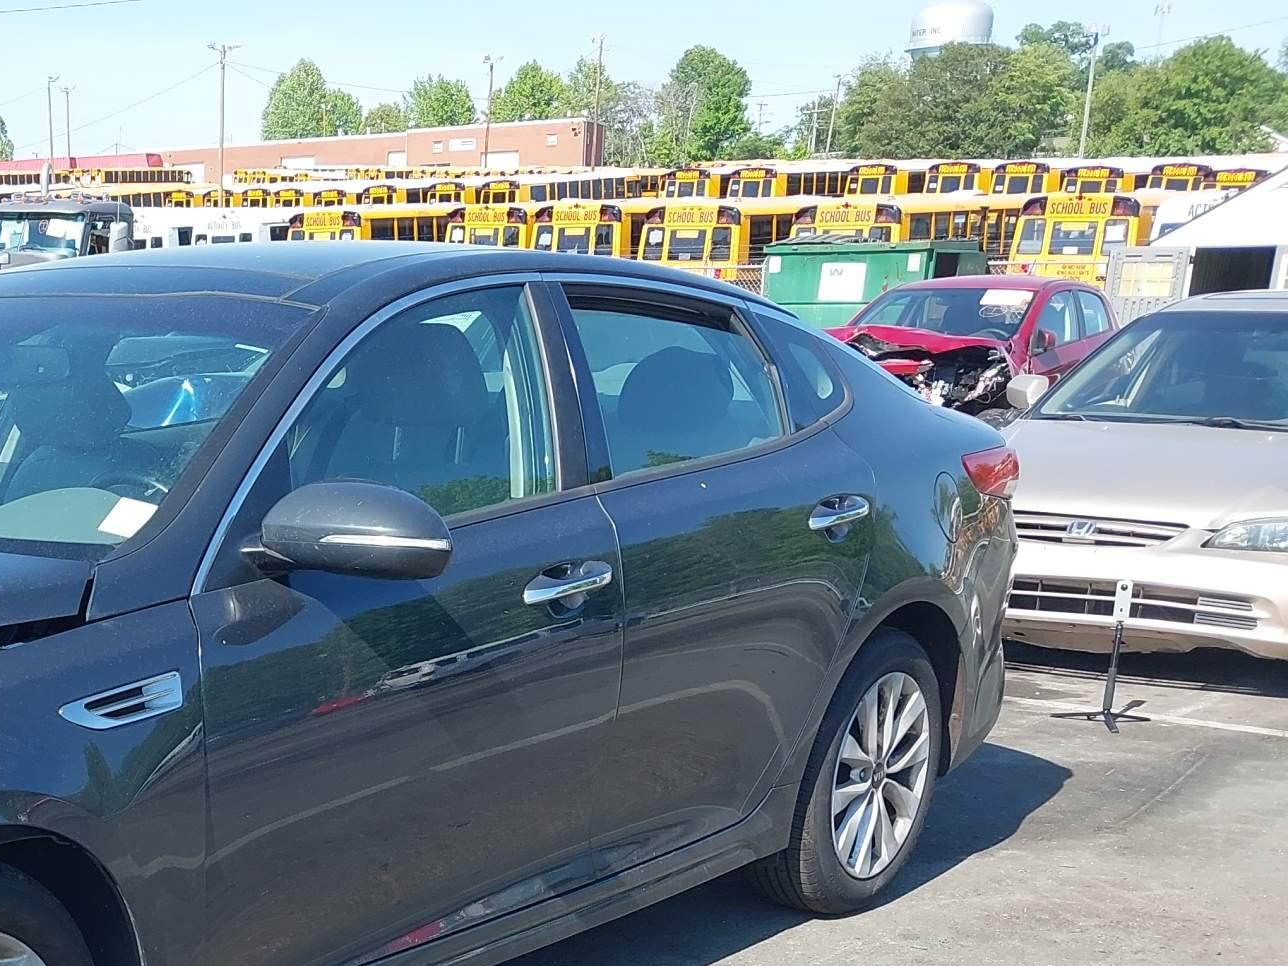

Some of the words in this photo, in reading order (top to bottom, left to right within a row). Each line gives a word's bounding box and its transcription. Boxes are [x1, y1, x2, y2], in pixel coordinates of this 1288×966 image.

[1050, 202, 1084, 215] SCHOOL
[1089, 202, 1108, 214] BUS
[305, 215, 327, 226] SCHOOL
[329, 215, 340, 226] BUS
[467, 211, 490, 222] SCHOOL
[492, 211, 505, 222] BUS
[555, 210, 581, 221] SCHOOL
[584, 210, 597, 221] BUS
[667, 211, 696, 223] SCHOOL
[699, 211, 714, 223] BUS
[820, 211, 850, 223] SCHOOL
[855, 210, 872, 222] BUS
